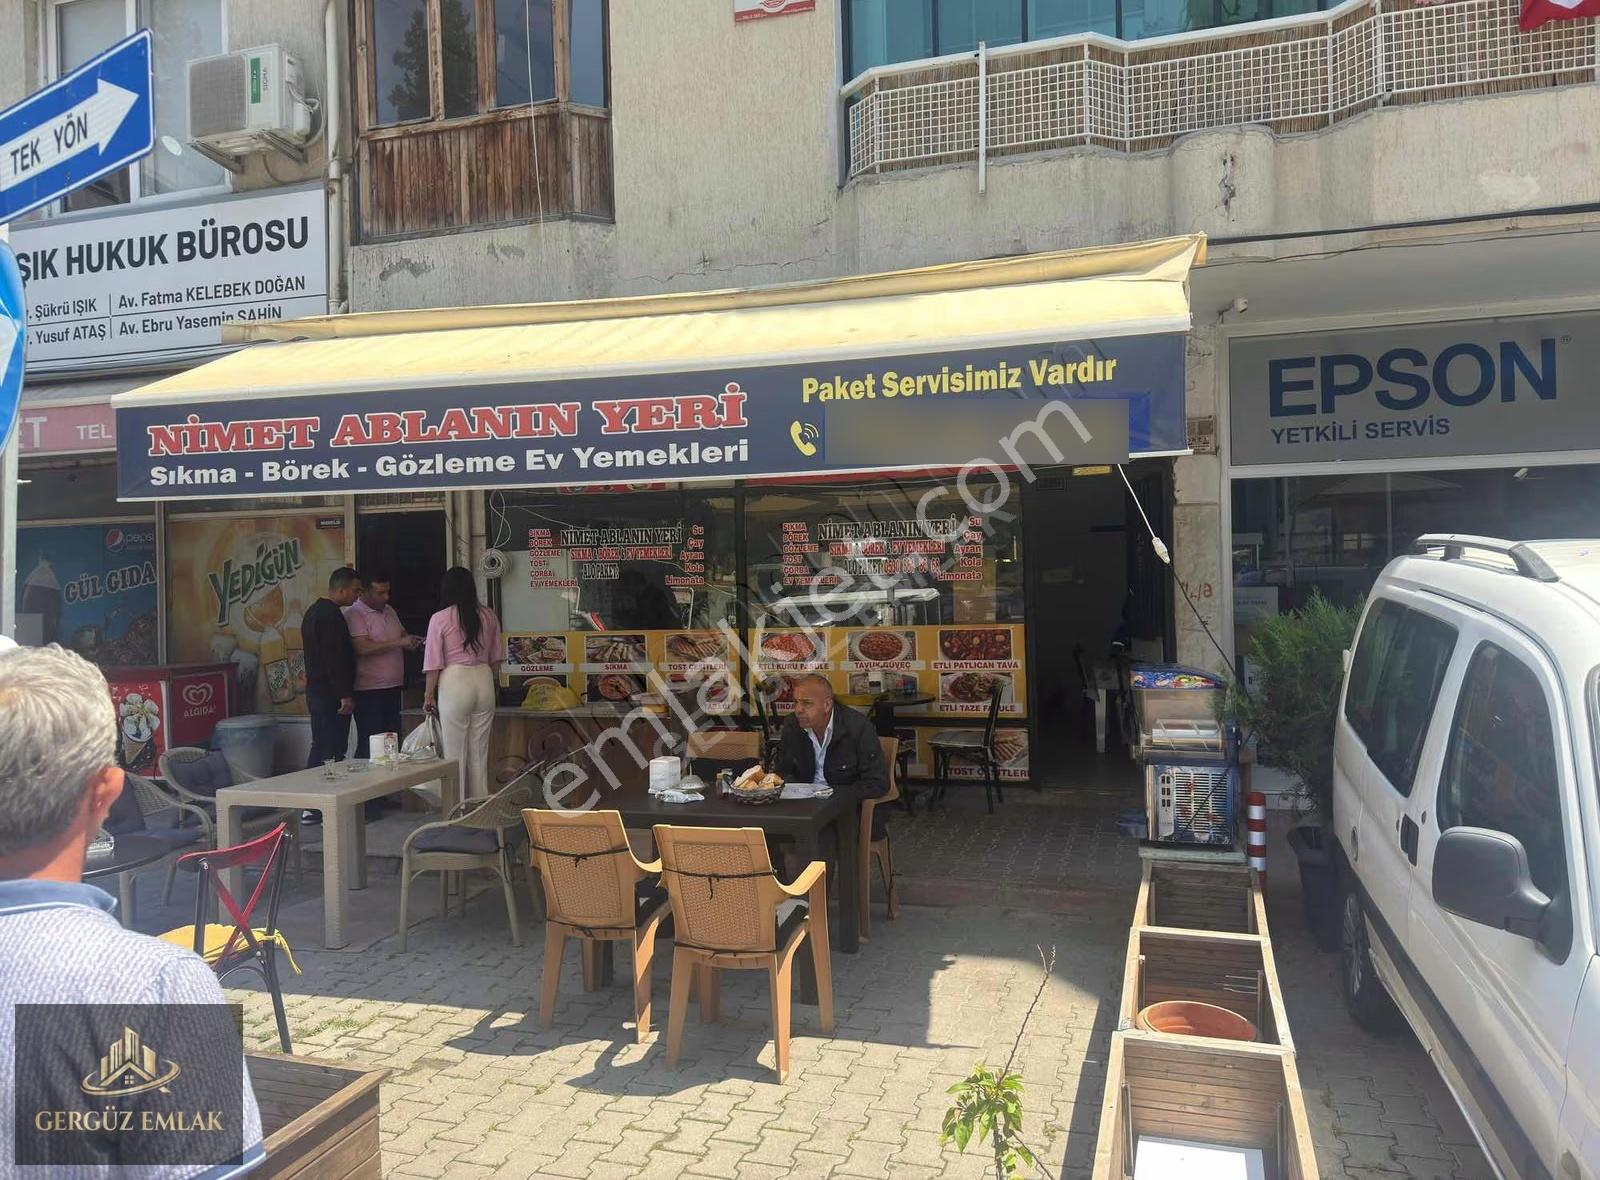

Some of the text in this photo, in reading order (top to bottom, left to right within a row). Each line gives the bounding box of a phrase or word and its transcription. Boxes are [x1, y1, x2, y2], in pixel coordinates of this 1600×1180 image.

[10, 113, 88, 175] TEK YÖN
[66, 233, 168, 277] HUKUK
[177, 216, 308, 263] BÜROSU
[118, 275, 305, 310] Av. Fatma KELEBEK DOĞAN
[35, 301, 69, 321] Şükrü
[73, 298, 97, 317] IŞIK
[119, 322, 139, 336] Av.
[142, 318, 173, 334] Ebru
[176, 312, 234, 331] Yasemin
[36, 327, 69, 345] Yusuf
[72, 324, 106, 342] ATAŞ
[802, 355, 1116, 403] Paket Servisimiz Vardır
[1268, 338, 1557, 418] EPSON
[147, 381, 748, 457] NİMET ABLANIN YERİ
[76, 424, 112, 440] TEL
[1271, 413, 1450, 445] YETKİLİ SERVİS
[150, 465, 237, 486] Sıkma
[262, 459, 350, 482] Börek
[375, 453, 516, 478] Gözleme
[525, 449, 564, 471] Ev
[572, 439, 748, 468] Yemekleri
[783, 522, 807, 532] SIKMA
[968, 517, 982, 526] Su
[818, 514, 959, 541] NİMET ABLANIN YERİ
[561, 521, 683, 547] NİMET ABLANIN YERİ
[783, 532, 809, 542] BÖREK
[963, 530, 982, 541] Çay
[529, 549, 560, 558] GÖZLEME
[783, 543, 819, 553] GÖZLEME
[954, 544, 982, 555] Ayran
[680, 551, 704, 561] Ayran
[783, 554, 803, 564] TOST
[960, 556, 982, 567] Kola
[685, 562, 704, 572] Kola
[664, 574, 704, 585] Limonata
[938, 570, 982, 581] Limonata
[64, 561, 156, 604] GÜL GIDA
[520, 664, 554, 672] GÖZLEME
[604, 663, 628, 671] SIKMA
[668, 663, 688, 671] TOST
[953, 661, 995, 669] PATLICAN
[997, 661, 1018, 669] TAVA
[958, 704, 980, 712] TAZE
[982, 704, 1016, 712] FAULE
[949, 767, 975, 776] TOST
